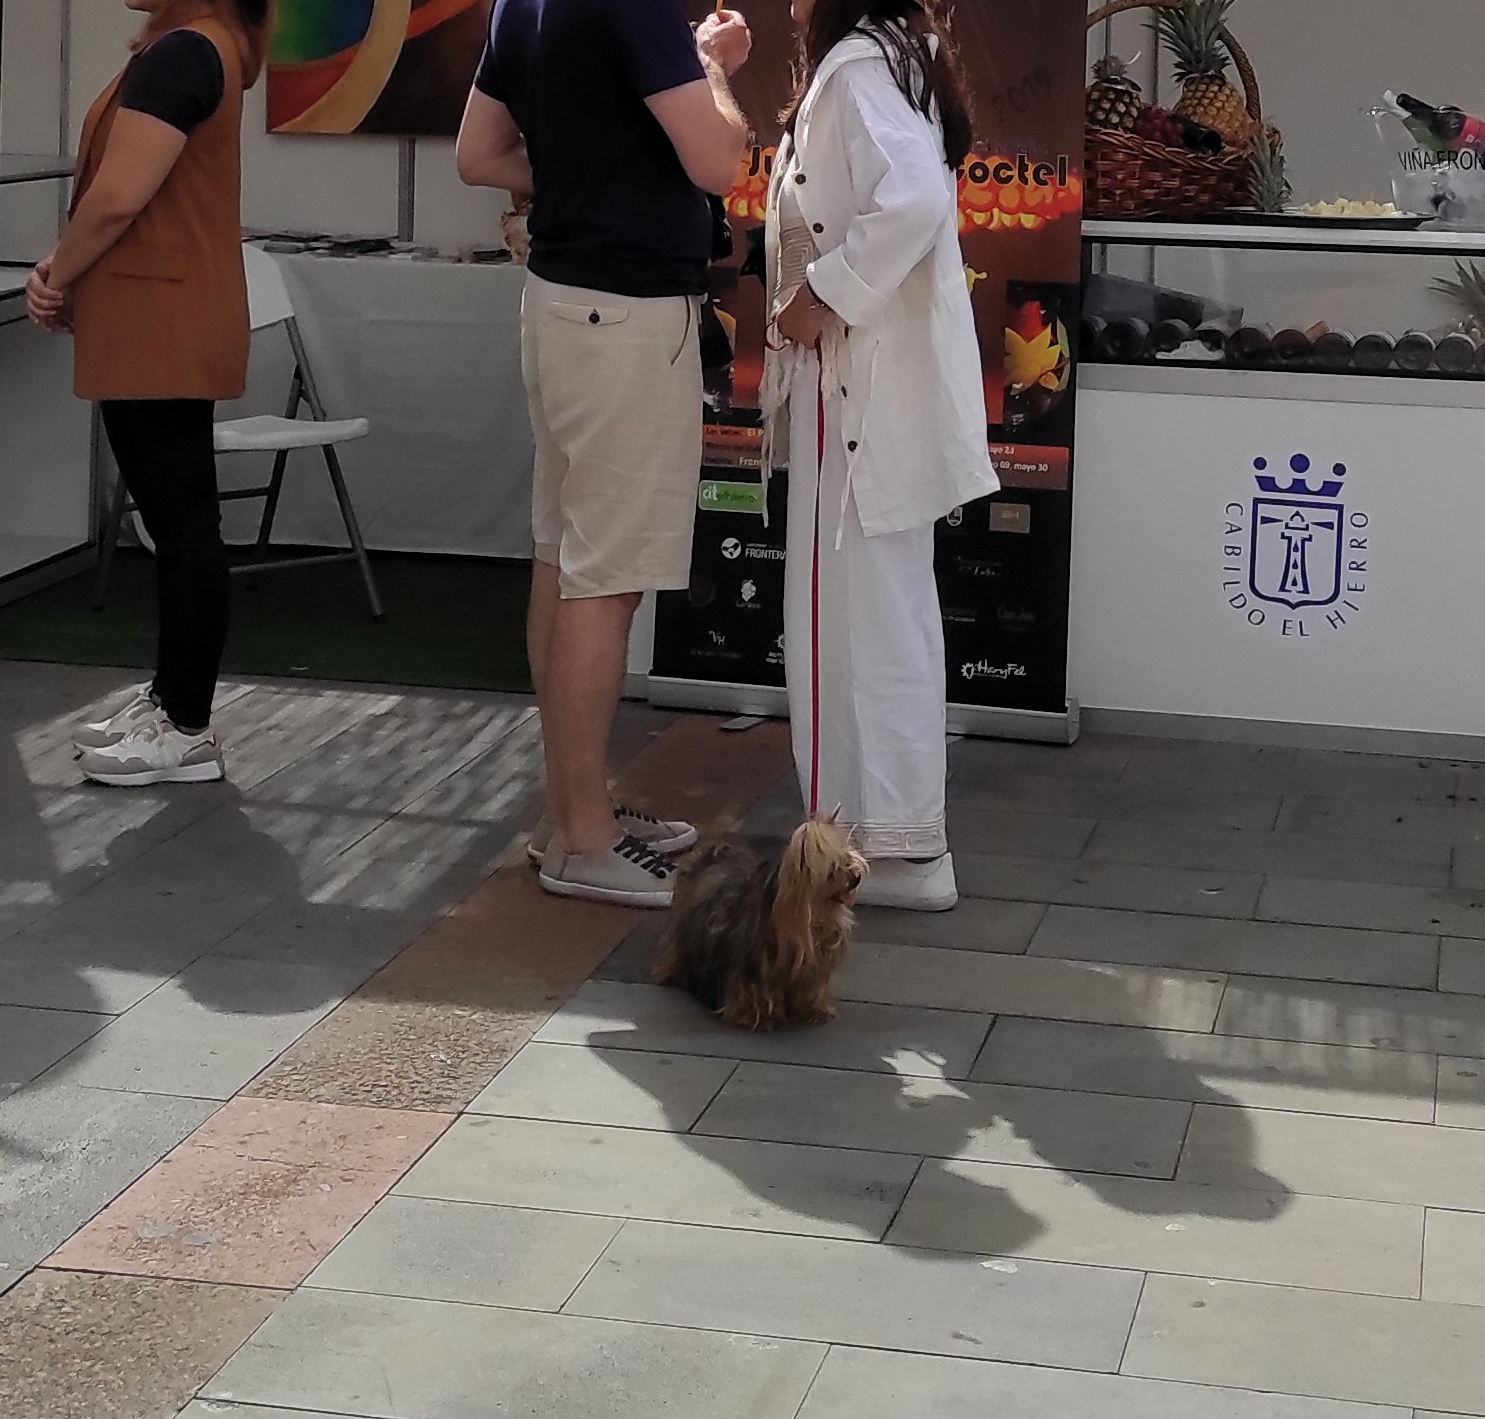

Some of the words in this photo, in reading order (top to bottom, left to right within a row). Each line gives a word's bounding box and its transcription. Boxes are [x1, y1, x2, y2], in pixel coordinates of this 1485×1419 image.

[1398, 147, 1432, 171] VIÑA
[1222, 502, 1266, 626] CABILDO
[1281, 618, 1310, 637] EL
[1325, 511, 1369, 630] HIERRO
